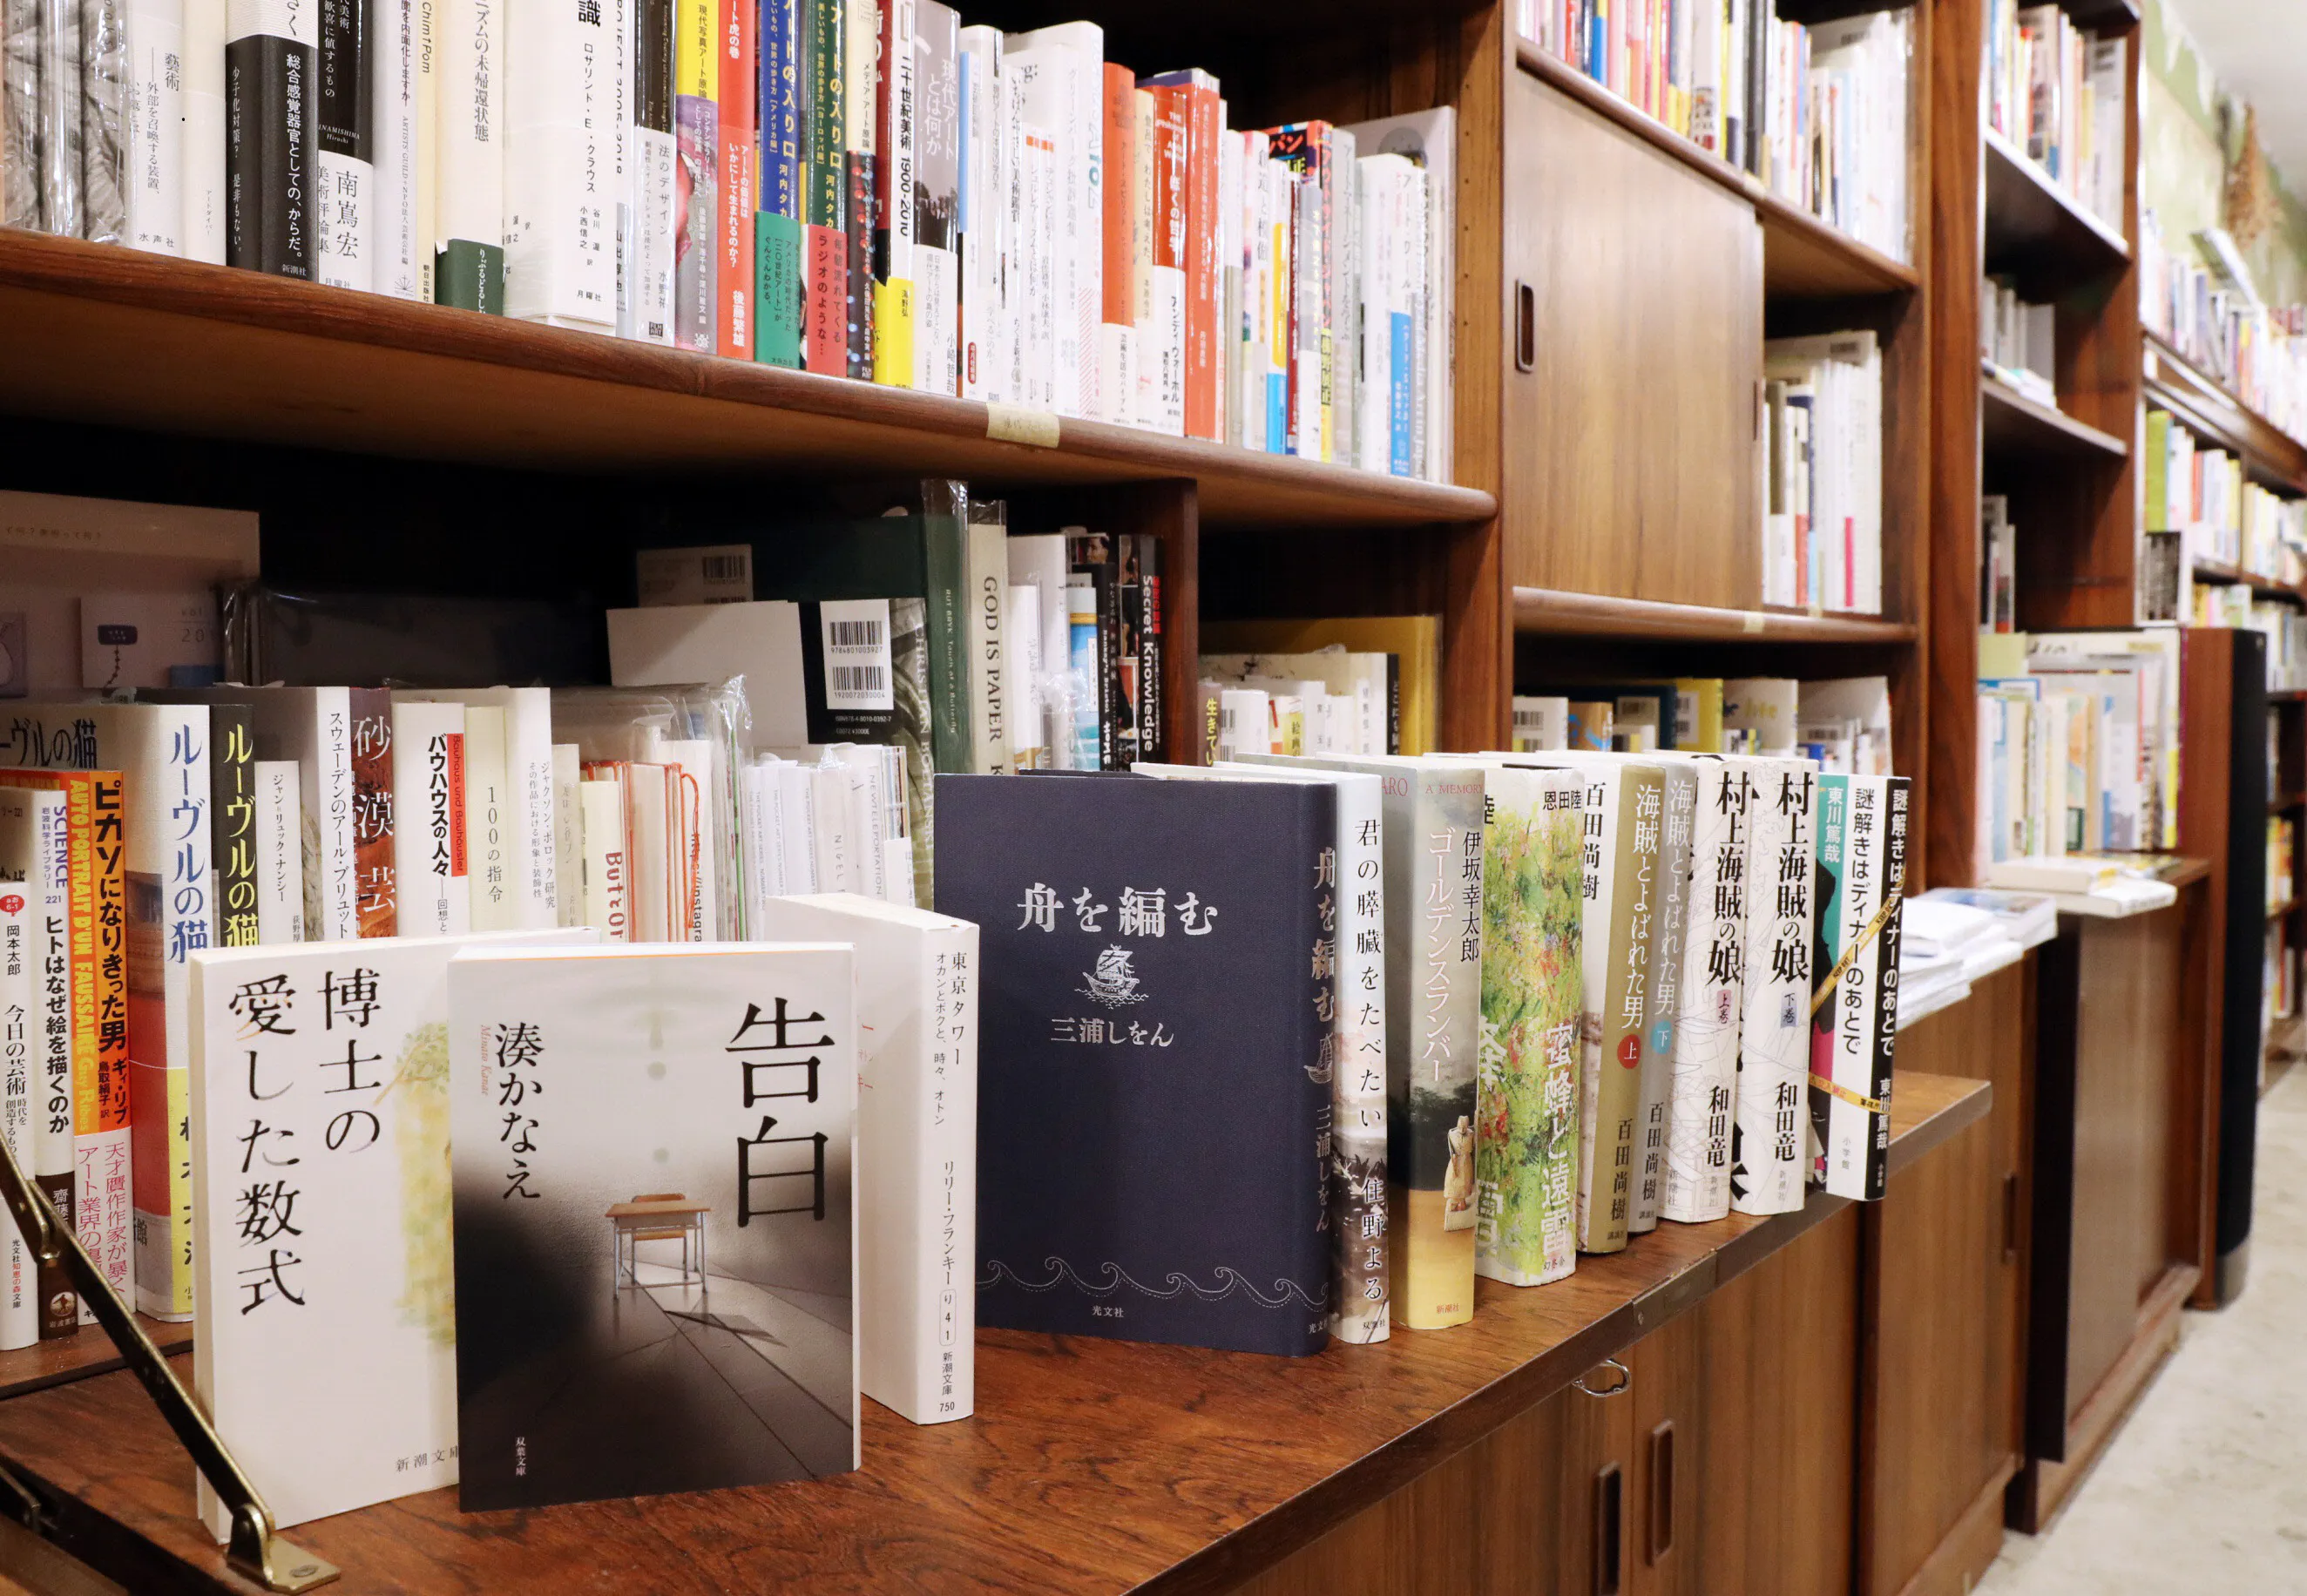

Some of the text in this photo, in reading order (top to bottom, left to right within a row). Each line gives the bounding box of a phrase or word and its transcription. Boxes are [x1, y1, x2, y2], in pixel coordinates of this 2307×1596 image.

[164, 52, 180, 92] 藝術
[925, 78, 943, 155] とは何か
[941, 60, 957, 160] 現代アート
[286, 53, 302, 260] 総合感覚器官としての、からだ。
[658, 145, 670, 235] 法のデザイン
[139, 233, 174, 248] 水声社
[281, 263, 307, 276] 新潮社
[579, 206, 588, 249] 小西信之
[577, 289, 602, 302] 月曜社
[984, 576, 998, 632] GOD
[986, 639, 1000, 660] IS
[987, 669, 1004, 743] PAPER
[1141, 575, 1155, 752] Secret Knowledge
[428, 733, 450, 877] バウハウスの人々
[453, 734, 462, 783] Bauhaus
[454, 788, 463, 808] und
[1425, 784, 1434, 794] A
[1543, 790, 1581, 811] 恩田陸
[53, 806, 68, 889] SCIENCE
[169, 724, 208, 964] ルーヴルの猫
[223, 724, 260, 947] ルーヴルの猫
[329, 712, 350, 939] スウェーデンのアール・ブリュット
[529, 762, 542, 898] その作品における形象と装飾性
[541, 761, 556, 910] ジャクソン・ポロック研究
[1583, 781, 1607, 900] 百田尚樹
[1824, 787, 1844, 863] 東川篤哉
[95, 780, 127, 1052] ピカソになりきった男
[1018, 883, 1218, 938] 舟を編む
[1460, 831, 1481, 963] 伊坂幸太郎
[1621, 784, 1662, 1060] 海賊とよばれた男 上
[1654, 780, 1694, 1048] 海賊とよばれた男 下
[1707, 770, 1750, 1025] 村上海賊の娘 上巻
[1769, 771, 1814, 1025] 村上海賊の娘 下巻
[1843, 788, 1875, 1054] 謎解きはディナーのあとで
[1881, 789, 1908, 1057] 謎解きはディナーのあとで
[7, 924, 21, 976] 岡本太郎
[1355, 819, 1382, 1127] 君の膵臓をたべたい
[1424, 827, 1458, 1081] ゴールデンスランバー
[3, 1004, 25, 1094] 今日の芸術
[45, 916, 70, 1134] ヒトはなぜ絵を描くのか
[951, 951, 968, 1065] 東京タワー
[1051, 1018, 1175, 1048] 三浦しをん
[316, 968, 382, 1154] 博士の
[17, 1099, 27, 1126] 時代を
[227, 973, 306, 1317] 愛した数式
[494, 1022, 545, 1201] 湊かなえ
[724, 996, 836, 1228] 告白
[1540, 1022, 1573, 1256] 蜜蜂と遠雷
[1642, 1102, 1665, 1201] 百田尚樹
[1707, 1085, 1729, 1168] 和田竜
[1774, 1081, 1797, 1162] 和田竜
[1877, 1078, 1891, 1150] 東川篤哉
[1611, 1118, 1633, 1221] 百田尚樹
[941, 1160, 956, 1286] リリー・フランキー
[1361, 1178, 1387, 1301] 住野よる
[12, 1240, 21, 1309] 光文社知恵の森文庫
[1092, 1304, 1125, 1318] 光文社
[1436, 1303, 1459, 1314] 新潮社
[939, 1401, 956, 1412] 750
[942, 1352, 953, 1396] 新潮文庫
[514, 1437, 528, 1477] 双葉文庫
